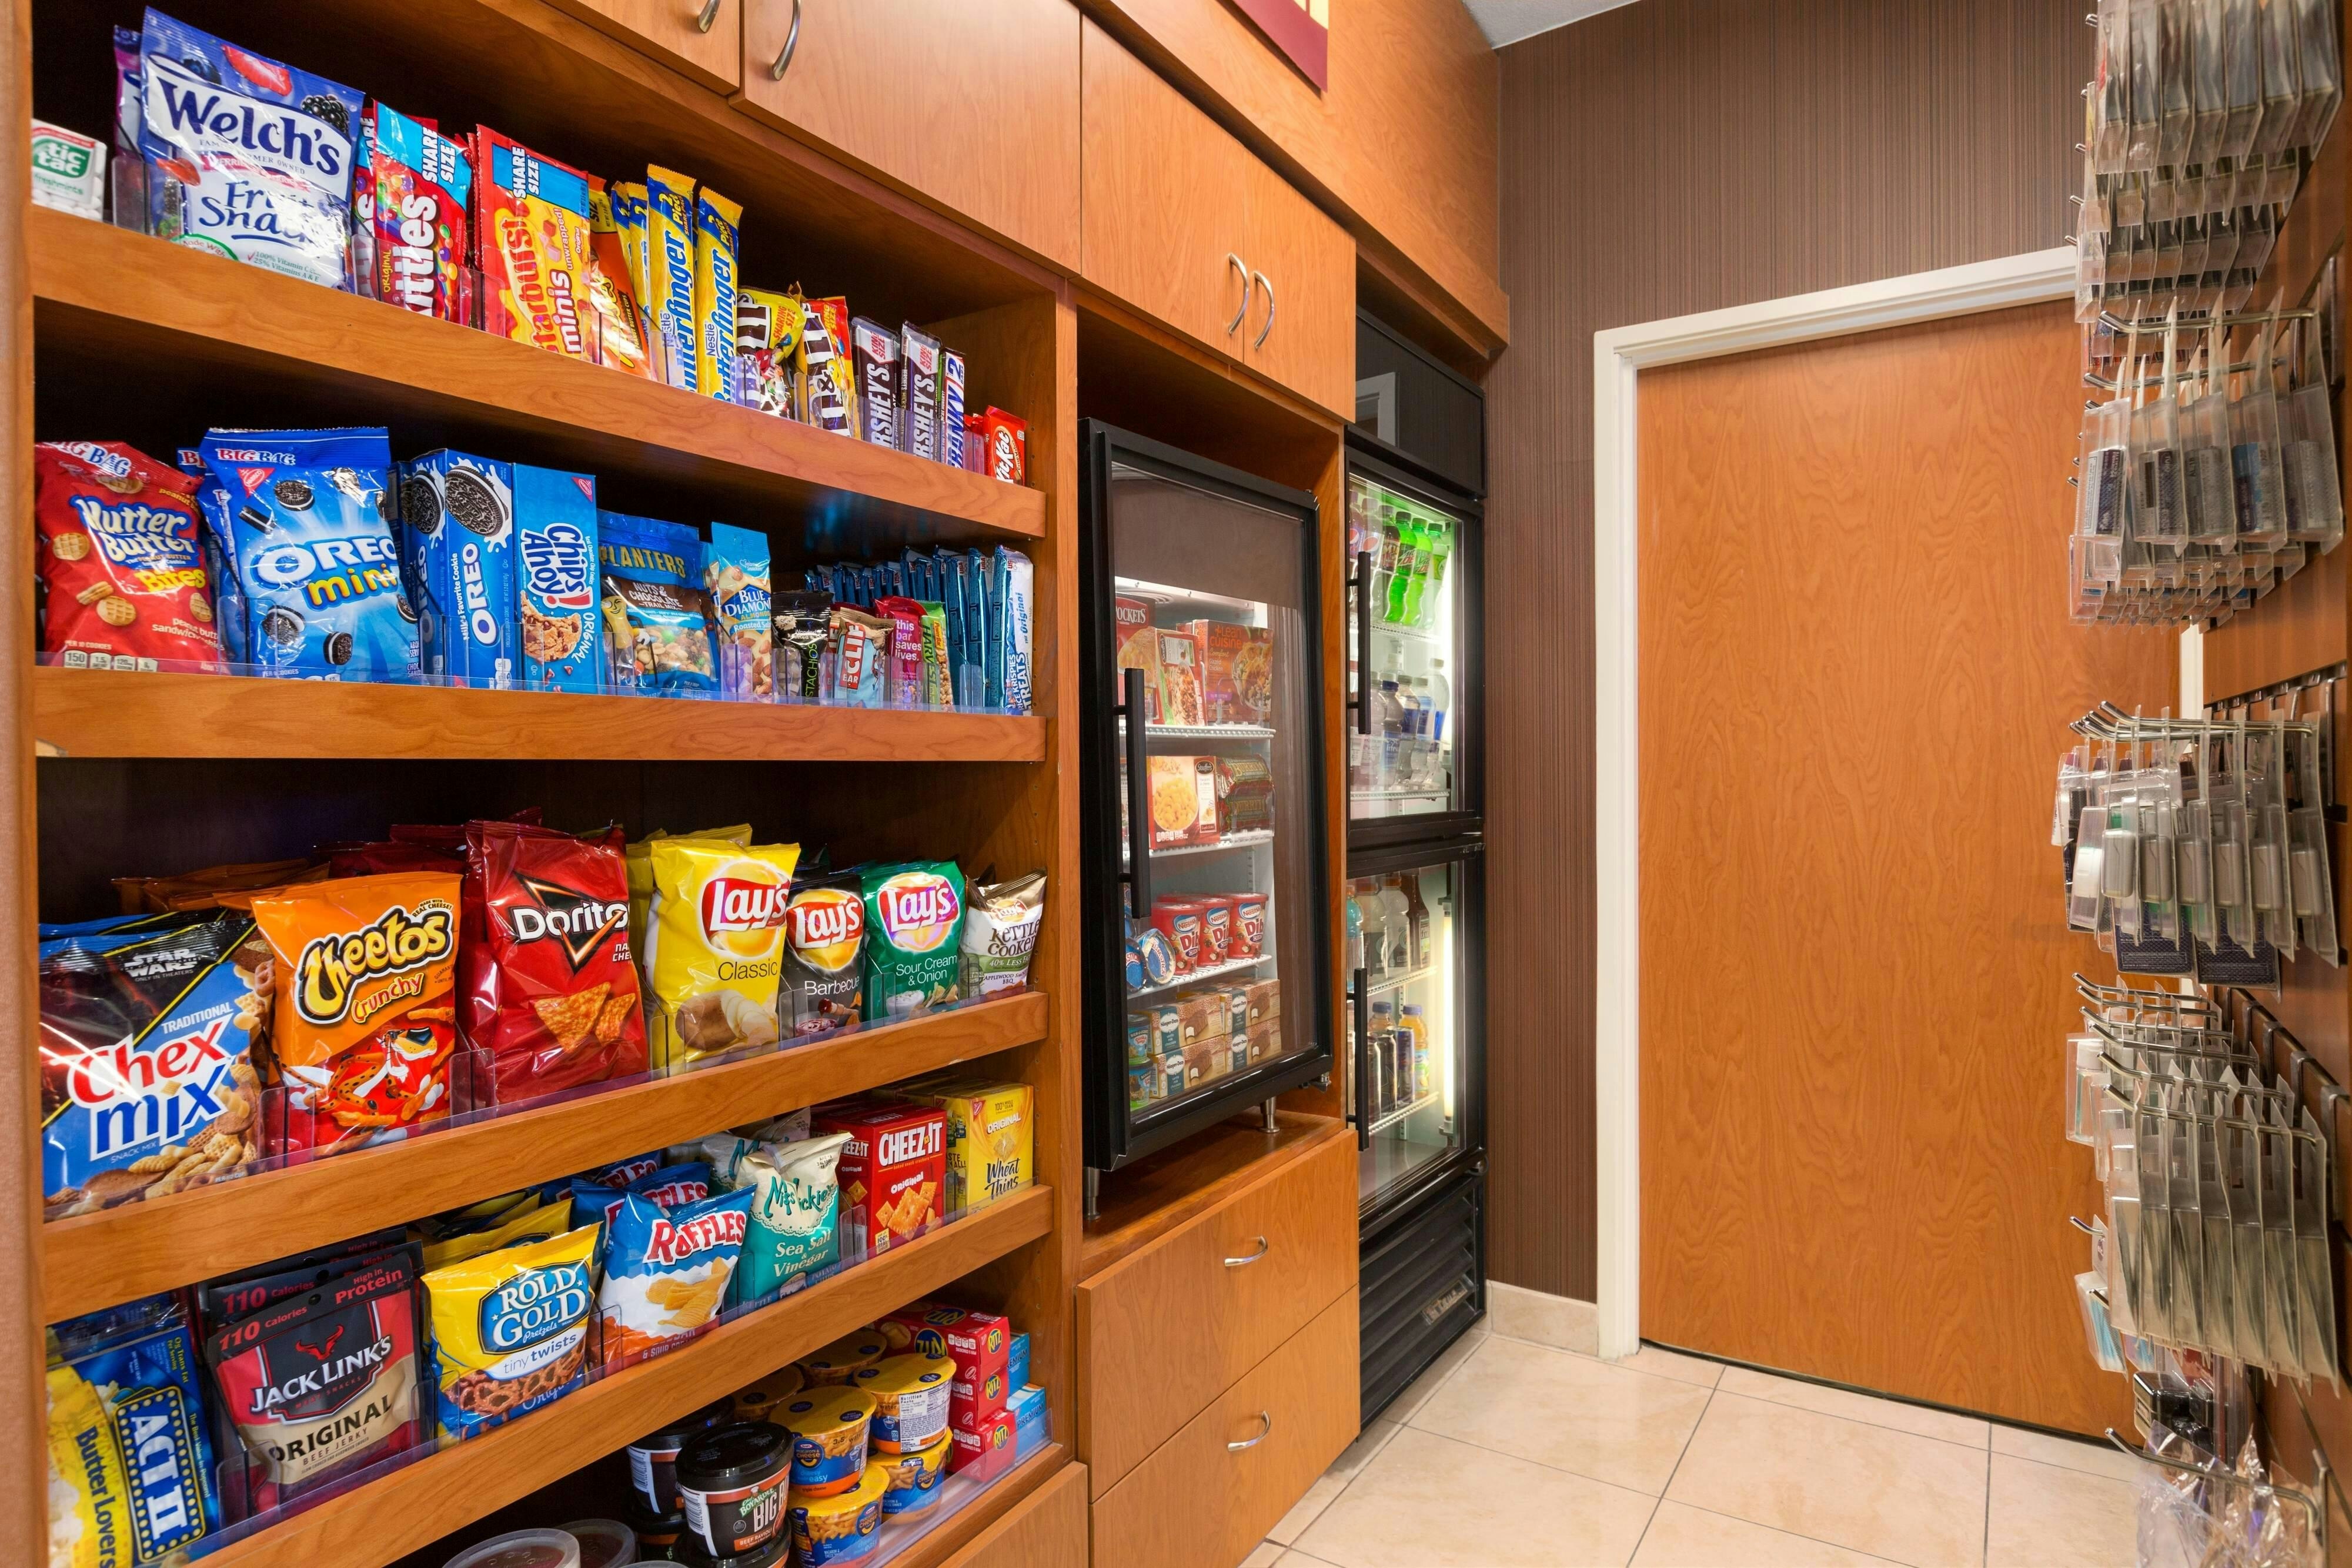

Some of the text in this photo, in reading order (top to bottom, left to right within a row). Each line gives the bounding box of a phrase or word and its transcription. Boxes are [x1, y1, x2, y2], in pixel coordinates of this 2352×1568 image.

[158, 77, 340, 175] Welch's
[38, 151, 81, 176] tac
[48, 142, 86, 165] tic
[422, 127, 439, 183] SHARE
[440, 145, 456, 183] SIZE
[513, 146, 526, 199] SHARE
[528, 158, 540, 196] SIZE
[659, 193, 673, 205] 2
[560, 208, 574, 270] unwrapped!
[254, 259, 270, 269] 25%
[272, 264, 300, 278] Vitamins
[255, 251, 276, 263] 100%
[277, 259, 302, 271] Vitamin
[550, 269, 582, 354] minis
[627, 308, 635, 329] BUTTER
[773, 305, 787, 340] SHARING
[786, 309, 796, 330] SIZE
[878, 335, 886, 360] SIZE
[947, 357, 961, 377] 2
[89, 445, 131, 477] BAG
[217, 449, 296, 466] BIG BAG
[75, 498, 188, 537] Nutter
[103, 531, 195, 561] Butter
[546, 524, 586, 596] Chips
[257, 537, 396, 586] OREO
[599, 545, 686, 579] PLANTERS
[135, 569, 206, 593] Bites
[308, 563, 399, 606] mini
[452, 553, 465, 616] Favorite Cookie
[462, 542, 497, 646] OREO
[633, 581, 668, 597] NUTS &
[628, 589, 684, 608] CHOCOLATE
[644, 601, 665, 610] TRAIL
[724, 597, 771, 617] DIAMOND
[739, 590, 766, 604] BLUE
[733, 621, 761, 632] Roasted
[740, 611, 771, 621] ALMONDS
[896, 619, 915, 631] this
[1015, 592, 1028, 634] Original
[1115, 606, 1146, 624] OCKETS
[572, 612, 596, 663] ORIGINAL
[844, 624, 865, 674] CLIF
[895, 641, 922, 651] saves
[896, 630, 912, 640] bar
[66, 652, 86, 663] 150
[895, 650, 919, 662] lives.
[922, 624, 938, 688] HARVEST
[842, 674, 859, 684] BAR
[1008, 654, 1020, 691] KRISPIES
[1015, 652, 1032, 710] TREATS
[412, 902, 453, 918] REAL CHEESE!
[709, 881, 789, 931] Lay's
[886, 884, 951, 932] Lay's
[512, 902, 630, 941] Dorito
[795, 898, 860, 948] Lay's
[124, 948, 196, 967] STAR
[126, 961, 198, 977] WARS
[303, 912, 447, 1017] Cheetos
[718, 958, 778, 981] Classic
[896, 954, 958, 977] Sour Cream
[1007, 958, 1022, 967] LESS
[162, 969, 194, 979] THEATERS
[804, 975, 860, 996] Barbecue
[907, 968, 947, 986] & Onion
[984, 973, 1014, 981] APPLEWOOD
[352, 972, 423, 1024] Crunchy
[161, 1001, 234, 1035] TRADITIONAL
[72, 1022, 226, 1104] Chex
[987, 1112, 1022, 1135] ORIGINAL
[110, 1141, 158, 1164] SNACK MIX
[986, 1158, 1021, 1184] Wheat
[764, 1176, 795, 1218] Miss
[984, 1176, 1019, 1201] Thins
[647, 1211, 747, 1265] RUFFLES
[775, 1229, 833, 1259] Sea Salt
[353, 1267, 383, 1286] High in
[773, 1248, 830, 1278] Vinegar
[223, 1281, 315, 1315] 110 Calories
[334, 1268, 403, 1305] Protein
[498, 1267, 578, 1315] ROLD
[219, 1305, 308, 1352] 110 Calories
[493, 1291, 586, 1349] GOLD
[523, 1322, 558, 1345] Pretzels
[503, 1333, 577, 1375] tiny twists
[988, 1330, 1003, 1352] RITZ
[176, 1349, 189, 1383] Trans Fat
[250, 1335, 392, 1413] JACK LINK'S
[985, 1376, 1001, 1398] RITZ
[269, 1395, 393, 1462] ORIGINAL
[1017, 1403, 1044, 1427] PREMIUM
[192, 1426, 200, 1441] Best
[303, 1446, 330, 1466] BEEF
[335, 1427, 368, 1450] JERKY
[994, 1426, 1010, 1448] RITZ
[76, 1424, 108, 1497] Butter
[131, 1415, 179, 1487] ACT
[808, 1474, 828, 1483] easy
[739, 1487, 776, 1517] BOYARDEE
[753, 1492, 778, 1533] BIG
[739, 1527, 773, 1546] BEEF RAVIOLI
